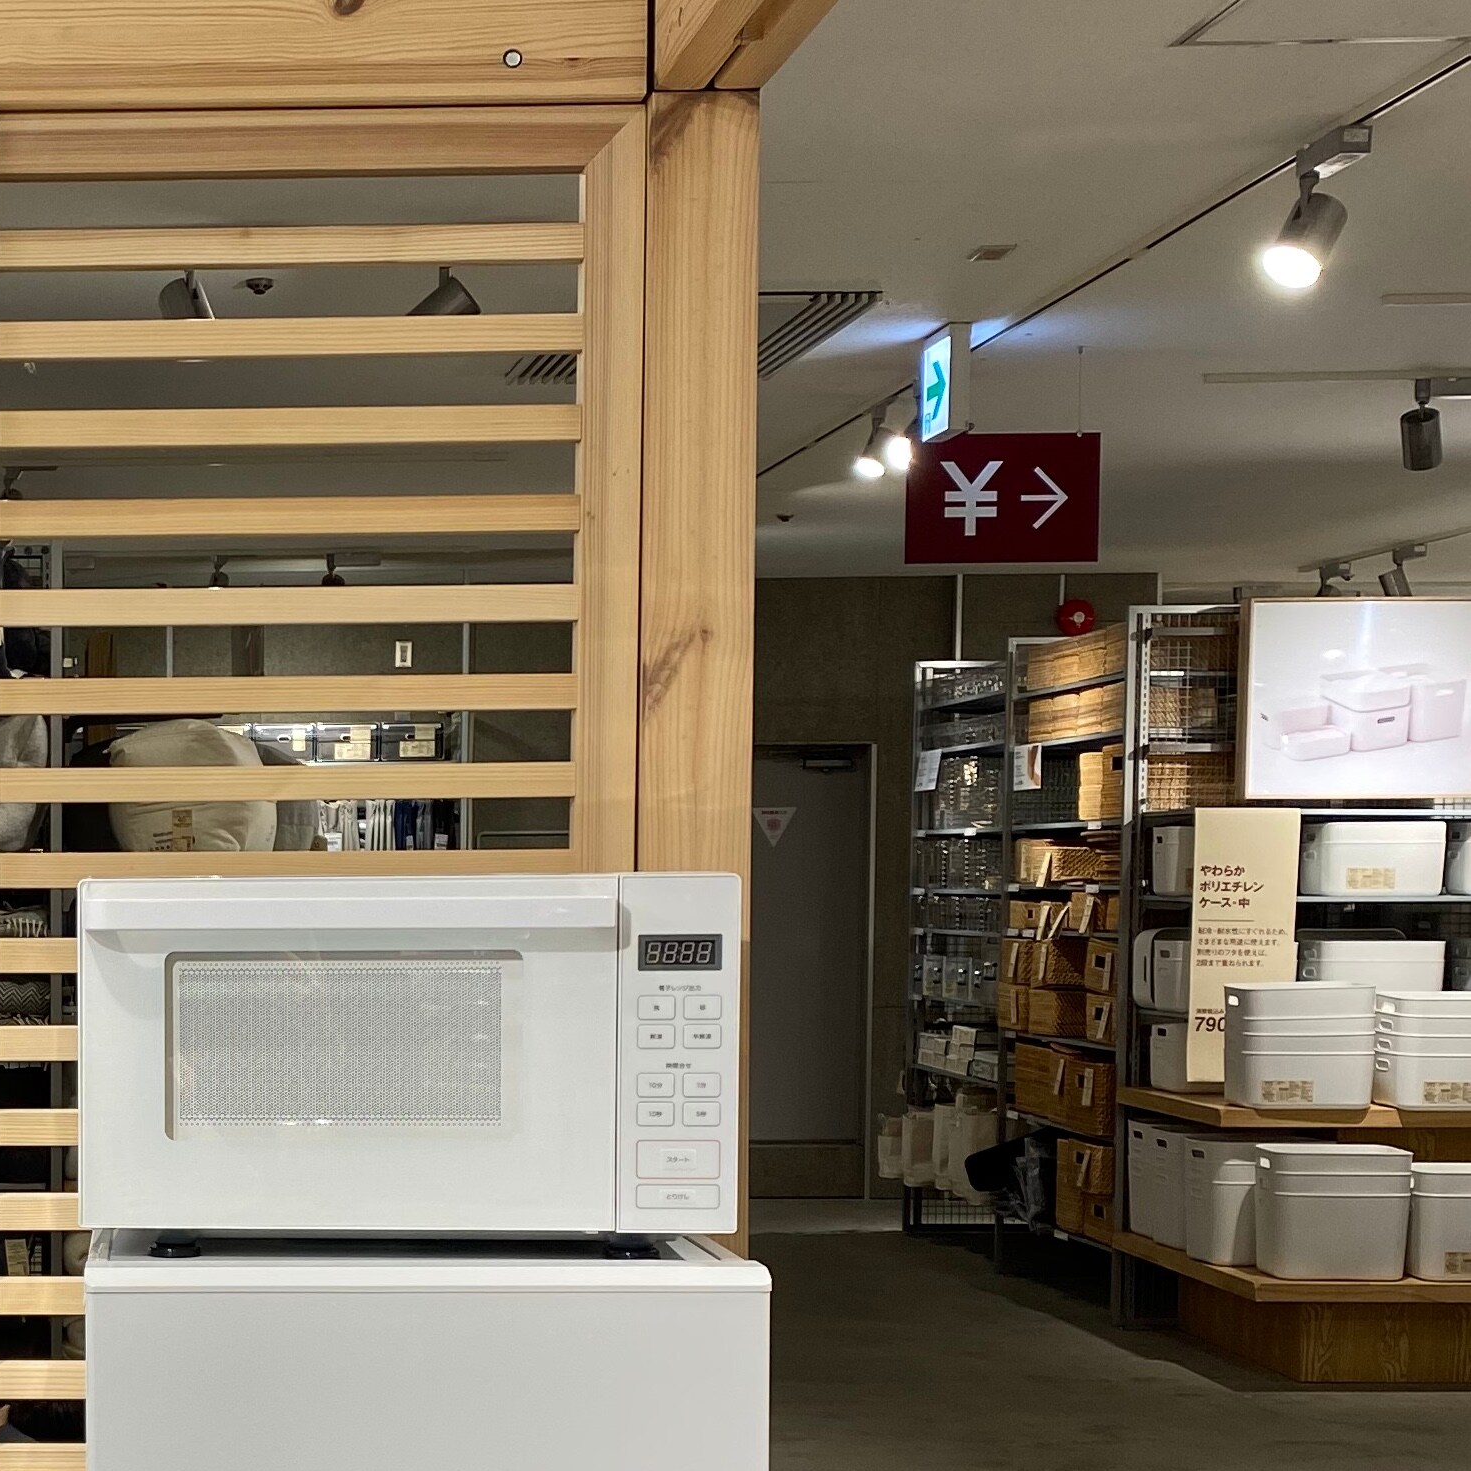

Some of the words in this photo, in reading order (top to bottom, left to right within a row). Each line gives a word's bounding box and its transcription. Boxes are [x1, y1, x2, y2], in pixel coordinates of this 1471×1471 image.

[940, 460, 1004, 536] ¥
[1200, 864, 1246, 877] やわらか
[1199, 880, 1264, 893] ポリエチレン
[1198, 896, 1251, 909] ケース・中
[1195, 1007, 1226, 1015] 消費税込み
